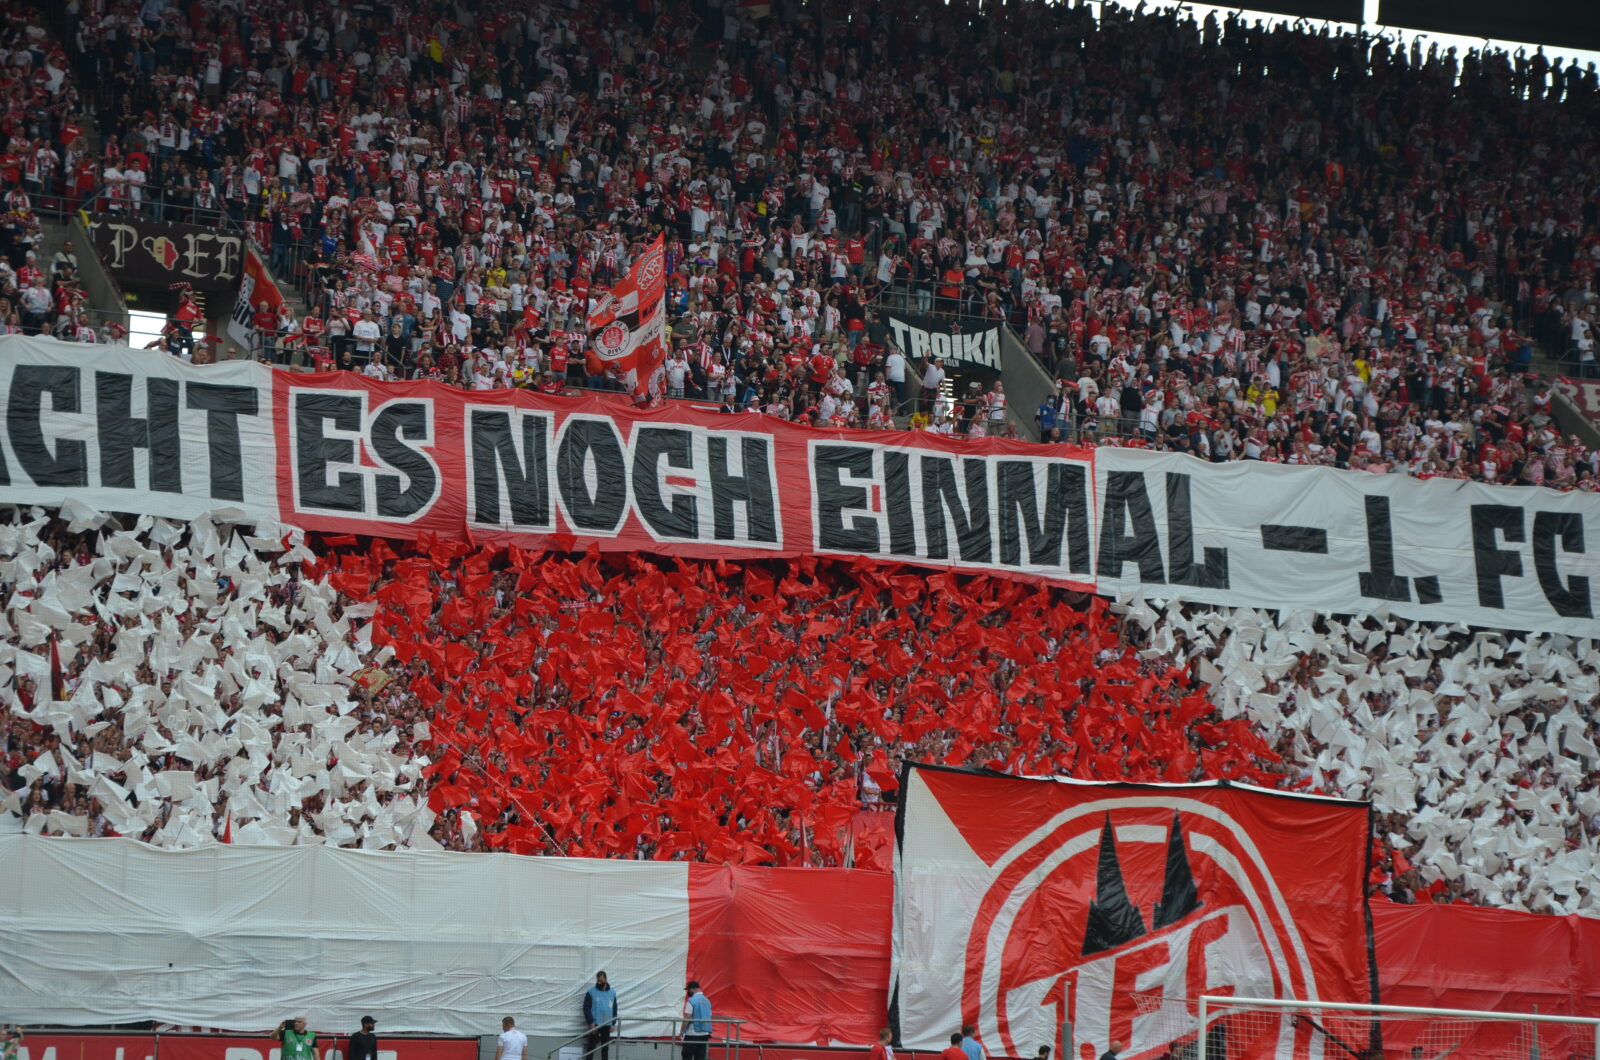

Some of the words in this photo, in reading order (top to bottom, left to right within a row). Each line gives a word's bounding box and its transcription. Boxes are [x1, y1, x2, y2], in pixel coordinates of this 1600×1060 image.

[889, 316, 1002, 371] TROIKA
[0, 364, 259, 502] CHT
[291, 388, 440, 521] ES
[468, 406, 780, 547] NOCH
[811, 442, 1230, 590] EINMAL
[1358, 494, 1443, 605] 1.
[1471, 504, 1594, 619] FC
